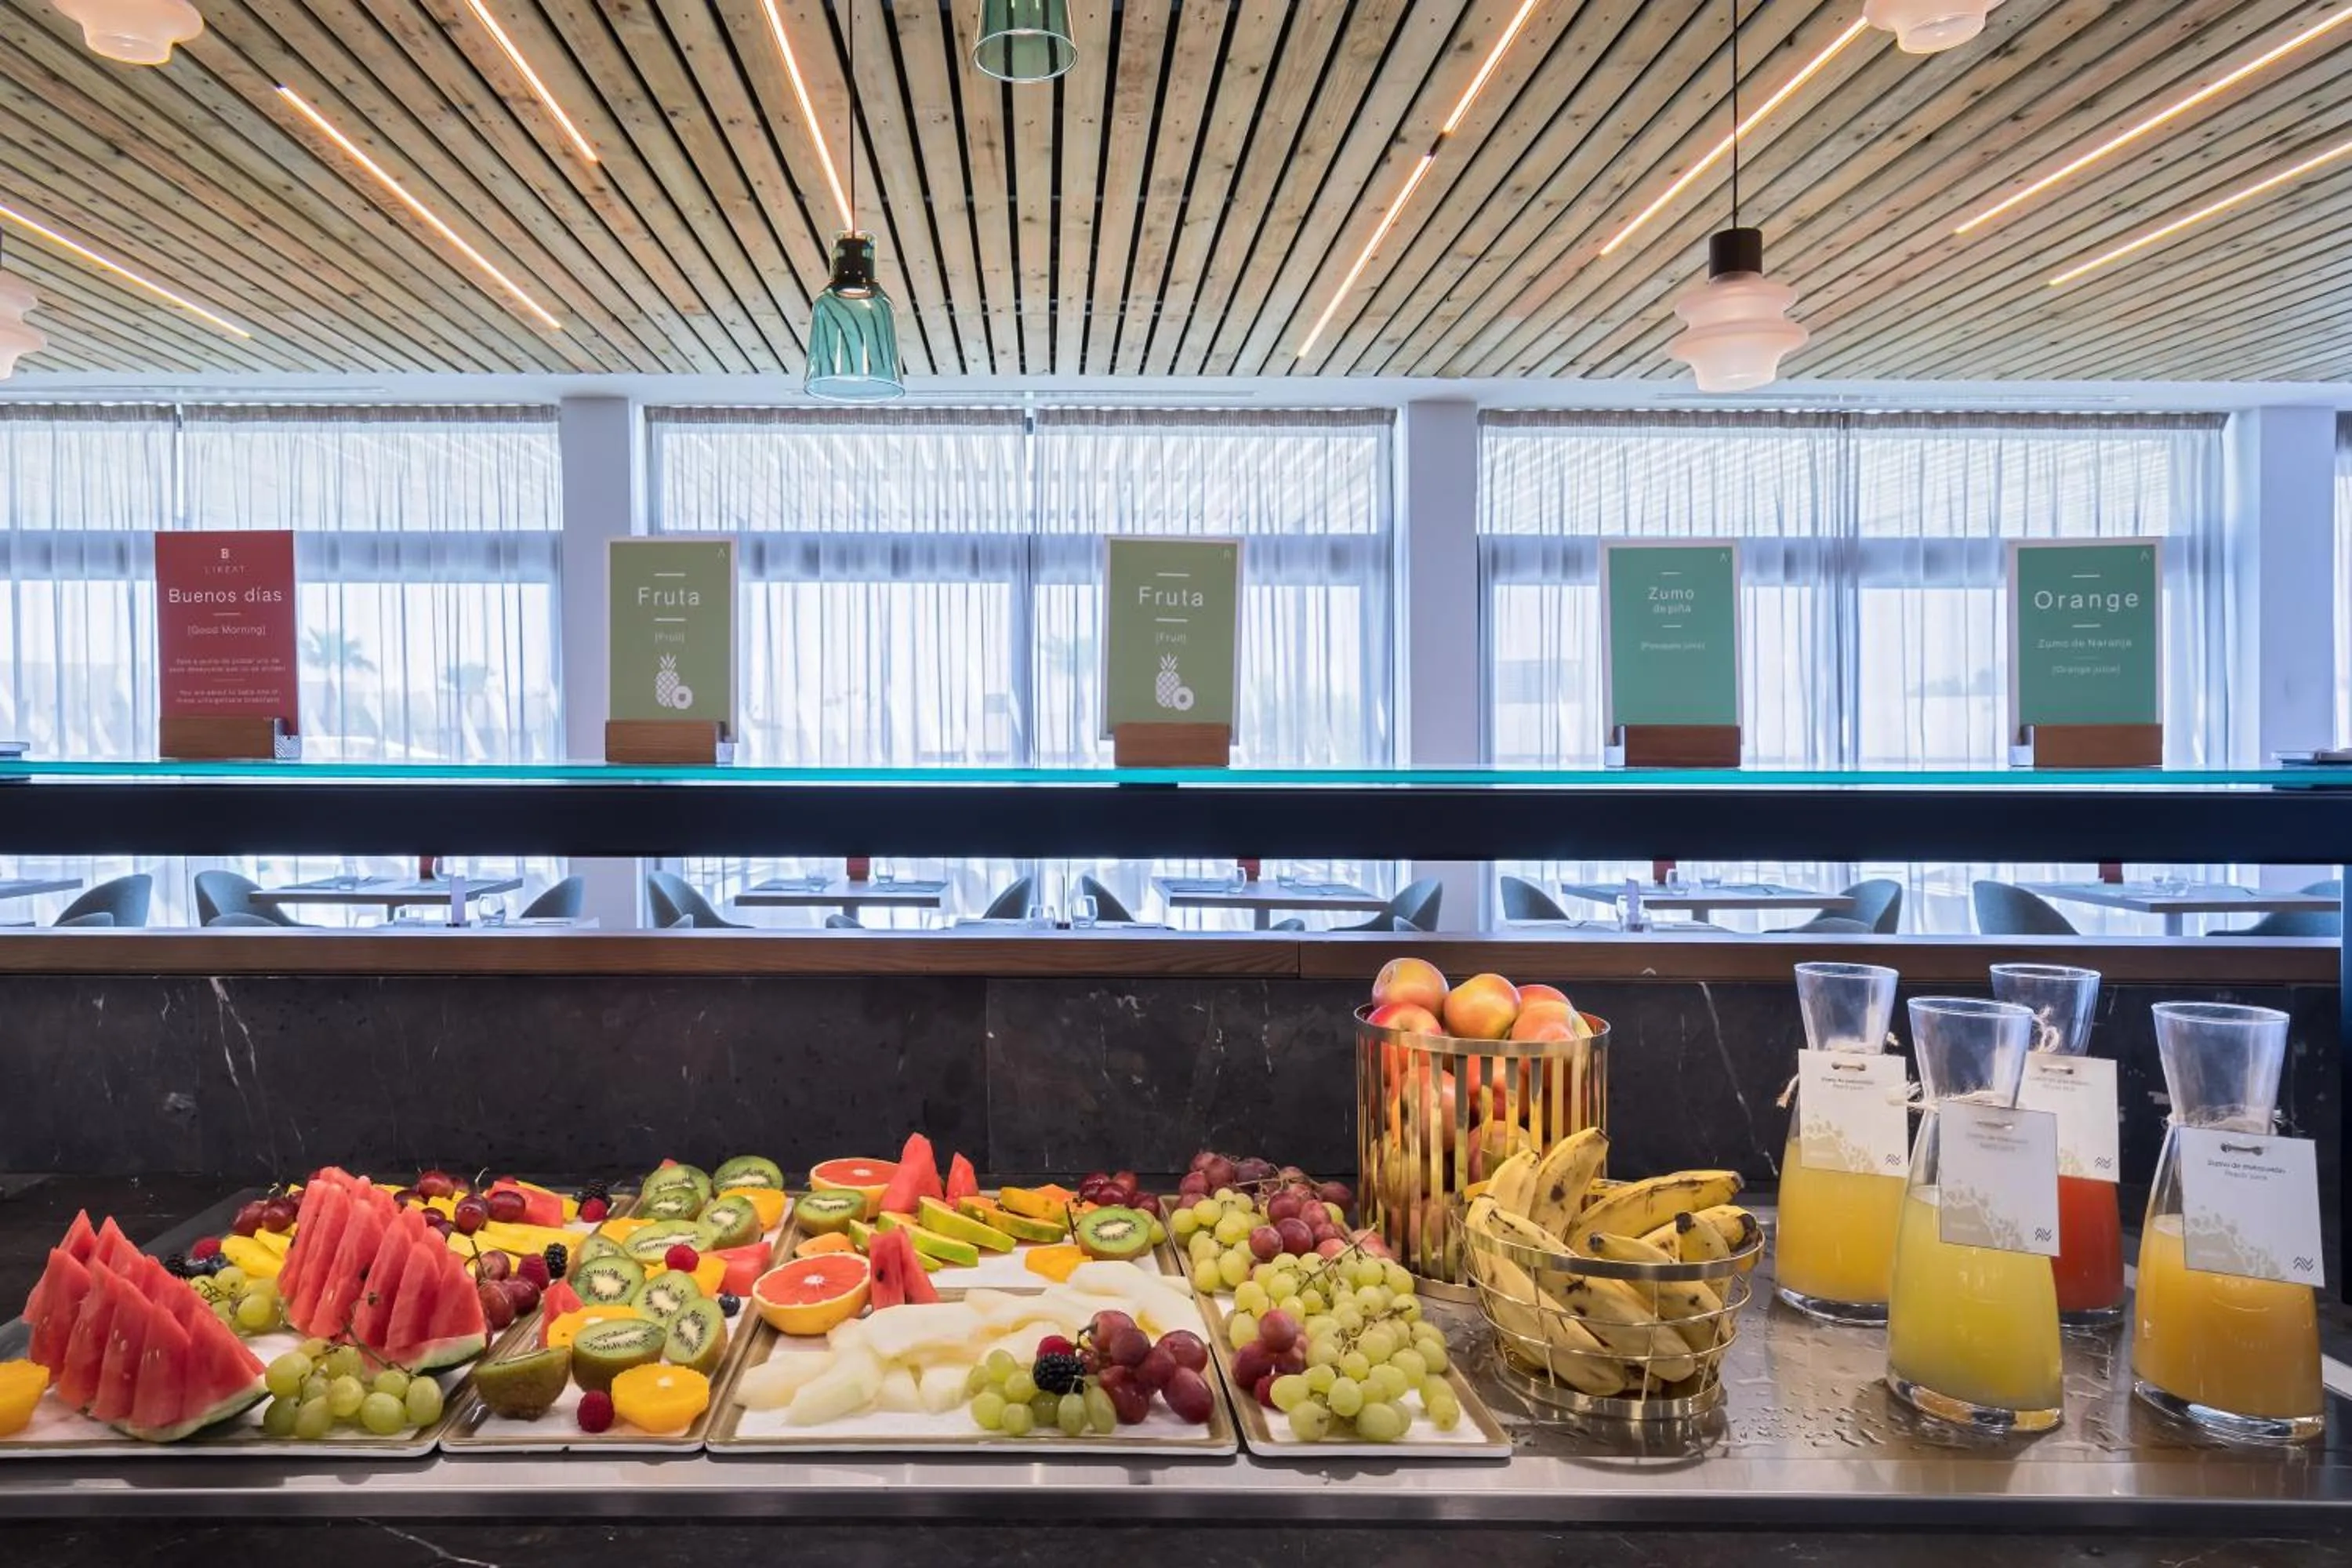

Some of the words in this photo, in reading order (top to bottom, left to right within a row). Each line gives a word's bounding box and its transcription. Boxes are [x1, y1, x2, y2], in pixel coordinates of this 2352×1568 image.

[168, 588, 238, 603] Buenos
[244, 586, 283, 603] días
[637, 586, 701, 606] Fruta
[1138, 586, 1204, 607] Fruta
[1648, 586, 1695, 601] Zumo
[2034, 590, 2140, 613] Orange
